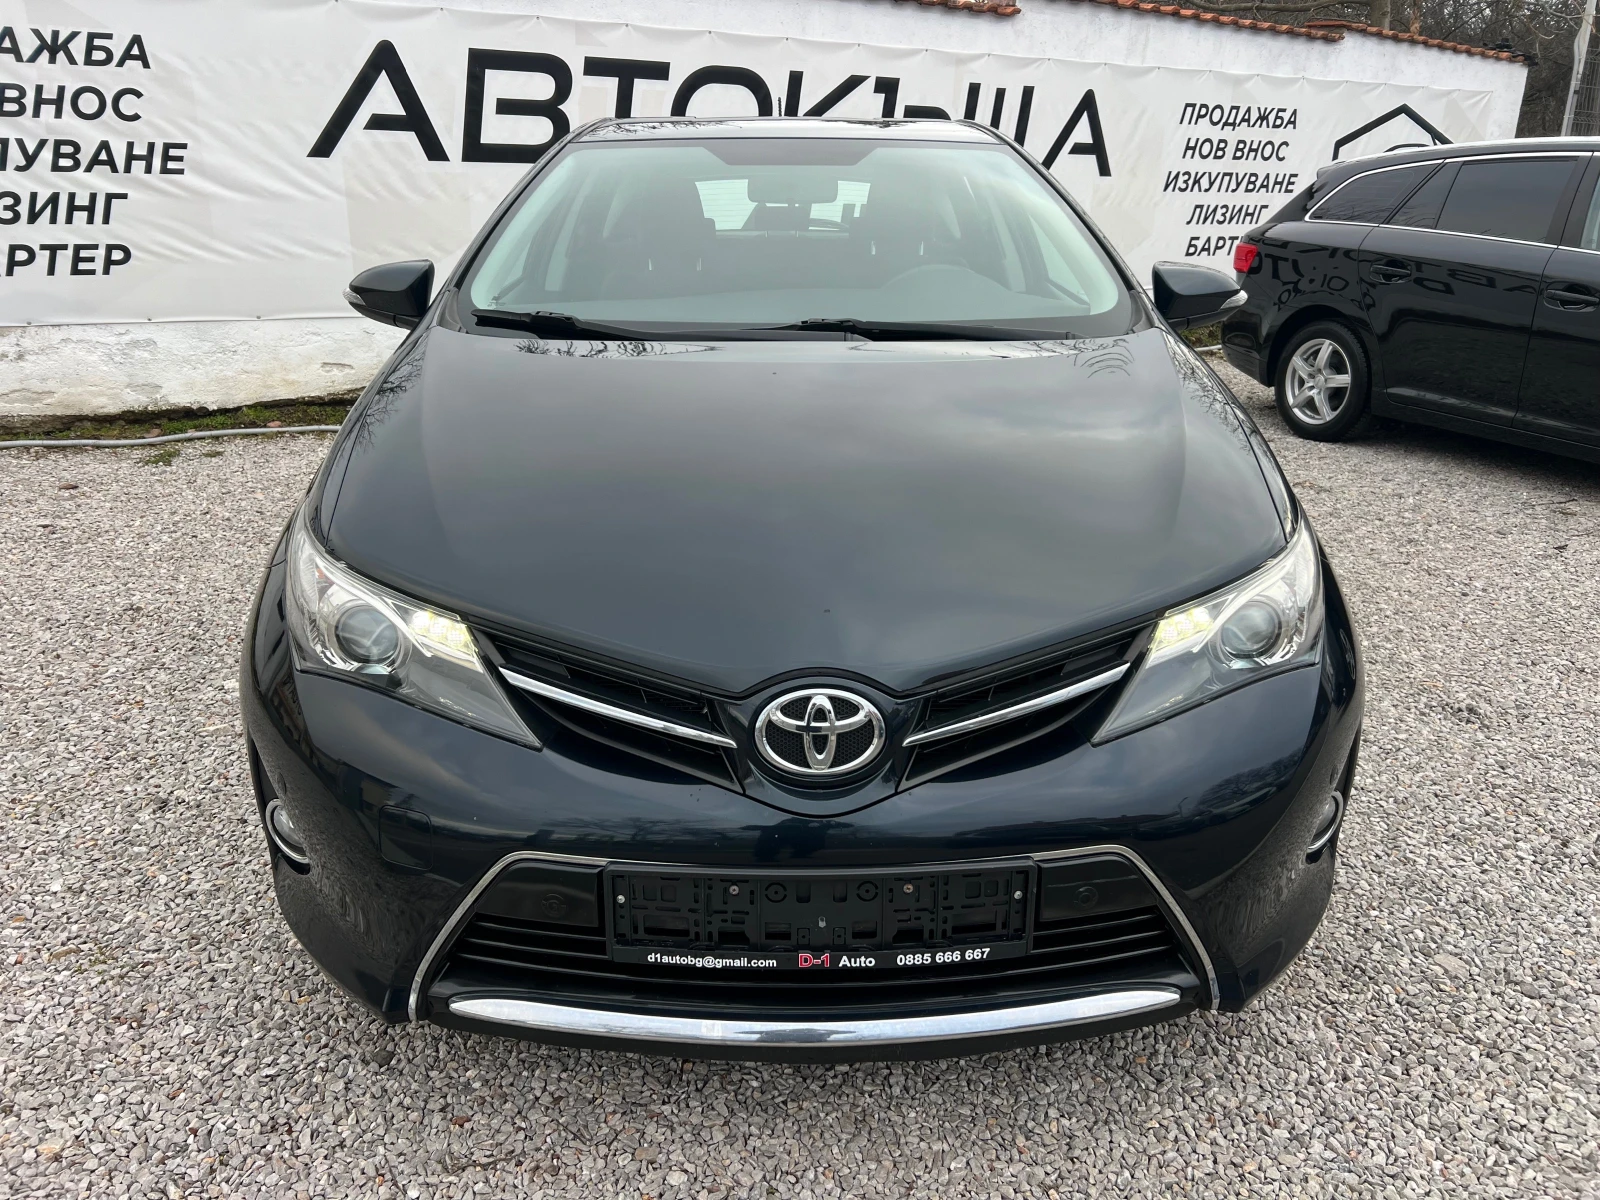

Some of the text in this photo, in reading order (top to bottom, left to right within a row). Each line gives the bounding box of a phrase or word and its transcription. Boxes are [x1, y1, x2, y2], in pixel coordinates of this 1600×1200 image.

[0, 82, 145, 122] ВНОС
[1179, 102, 1298, 131] ПРОДАЖБА
[1182, 137, 1290, 162] НОВ ВНОС
[1163, 170, 1299, 194] ИЗКУПУВАНЕ
[0, 190, 129, 226] ЗИНГ
[1185, 204, 1269, 226] ЛИЗИНГ
[1185, 235, 1245, 257] БАРТ
[0, 243, 132, 277] РТЕР
[647, 947, 991, 969] d1autobg@gmail.com D-1 Auto 0885 666 667
